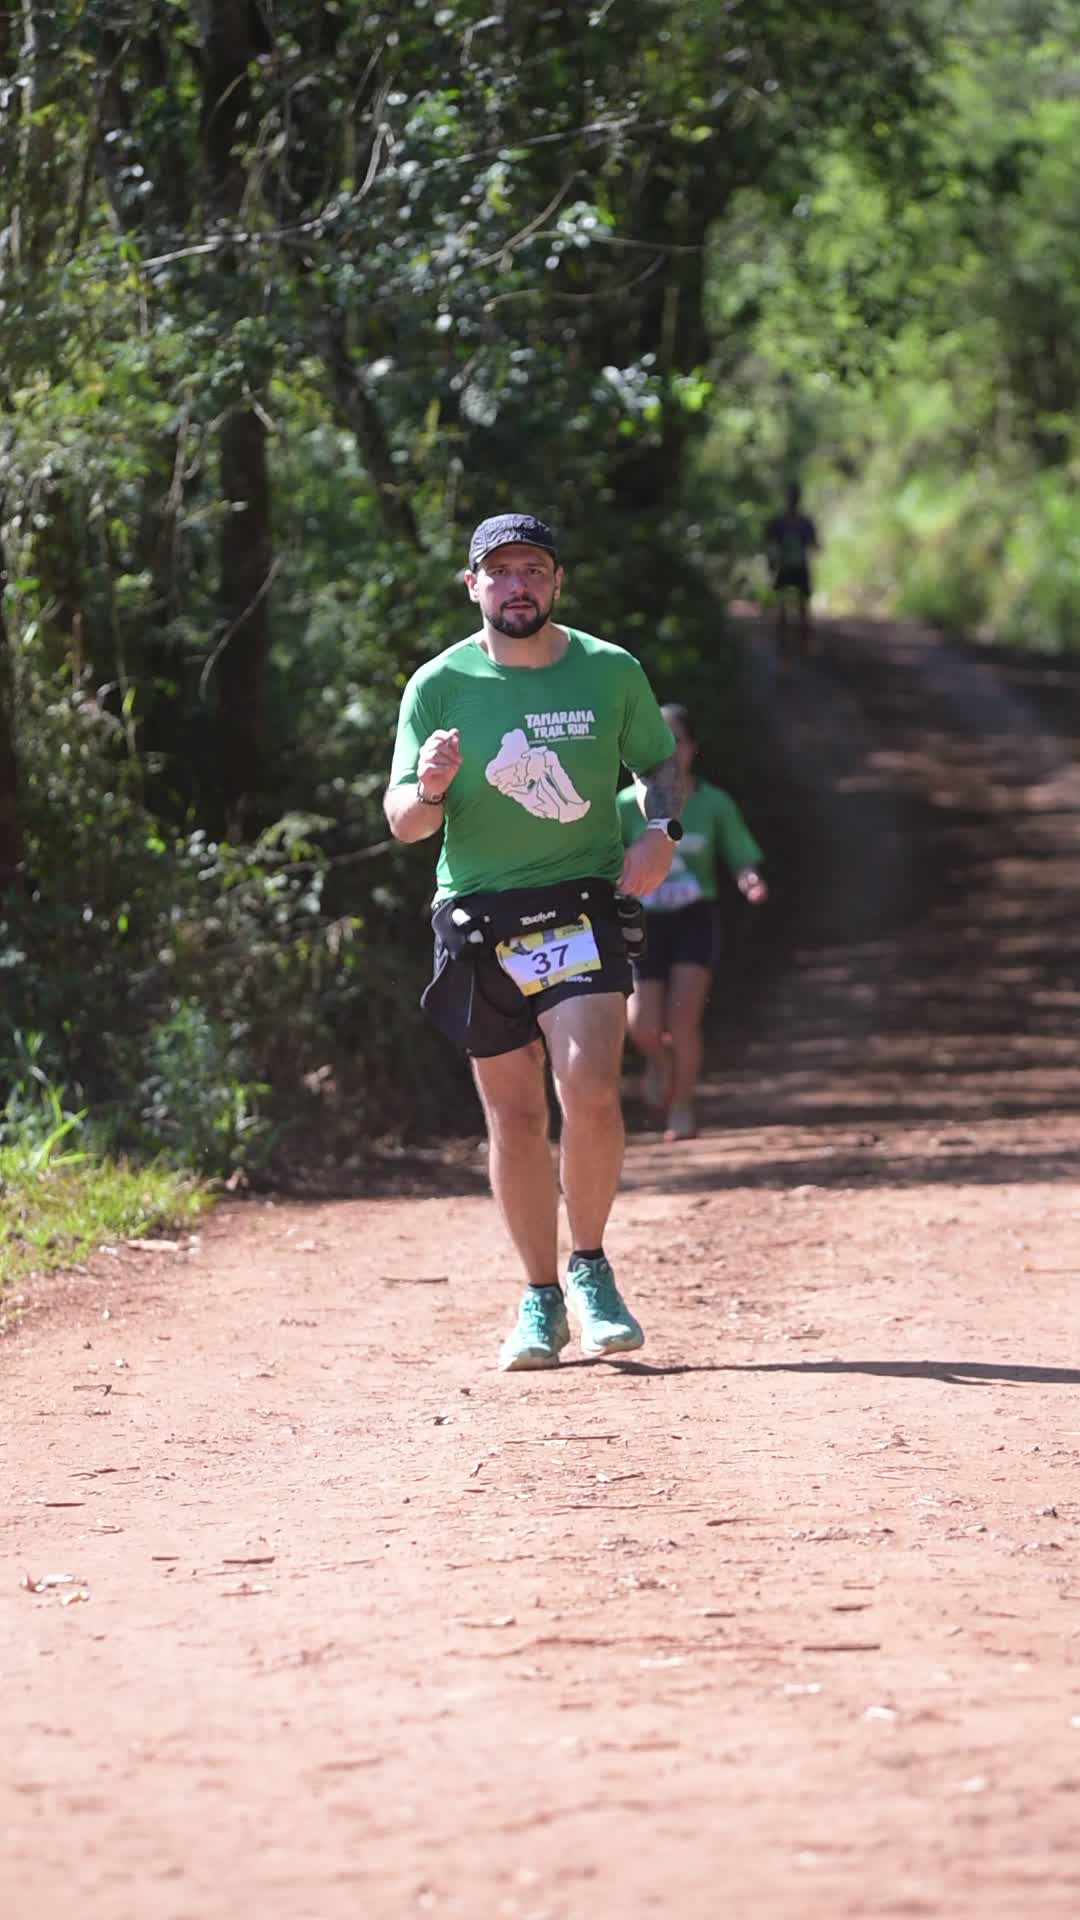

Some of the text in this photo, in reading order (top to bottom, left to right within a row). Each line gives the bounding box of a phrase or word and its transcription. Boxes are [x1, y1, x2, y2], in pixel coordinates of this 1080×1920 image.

[524, 710, 596, 729] TAMARANA
[533, 723, 590, 738] TRAIL RUN
[531, 944, 569, 974] 37
